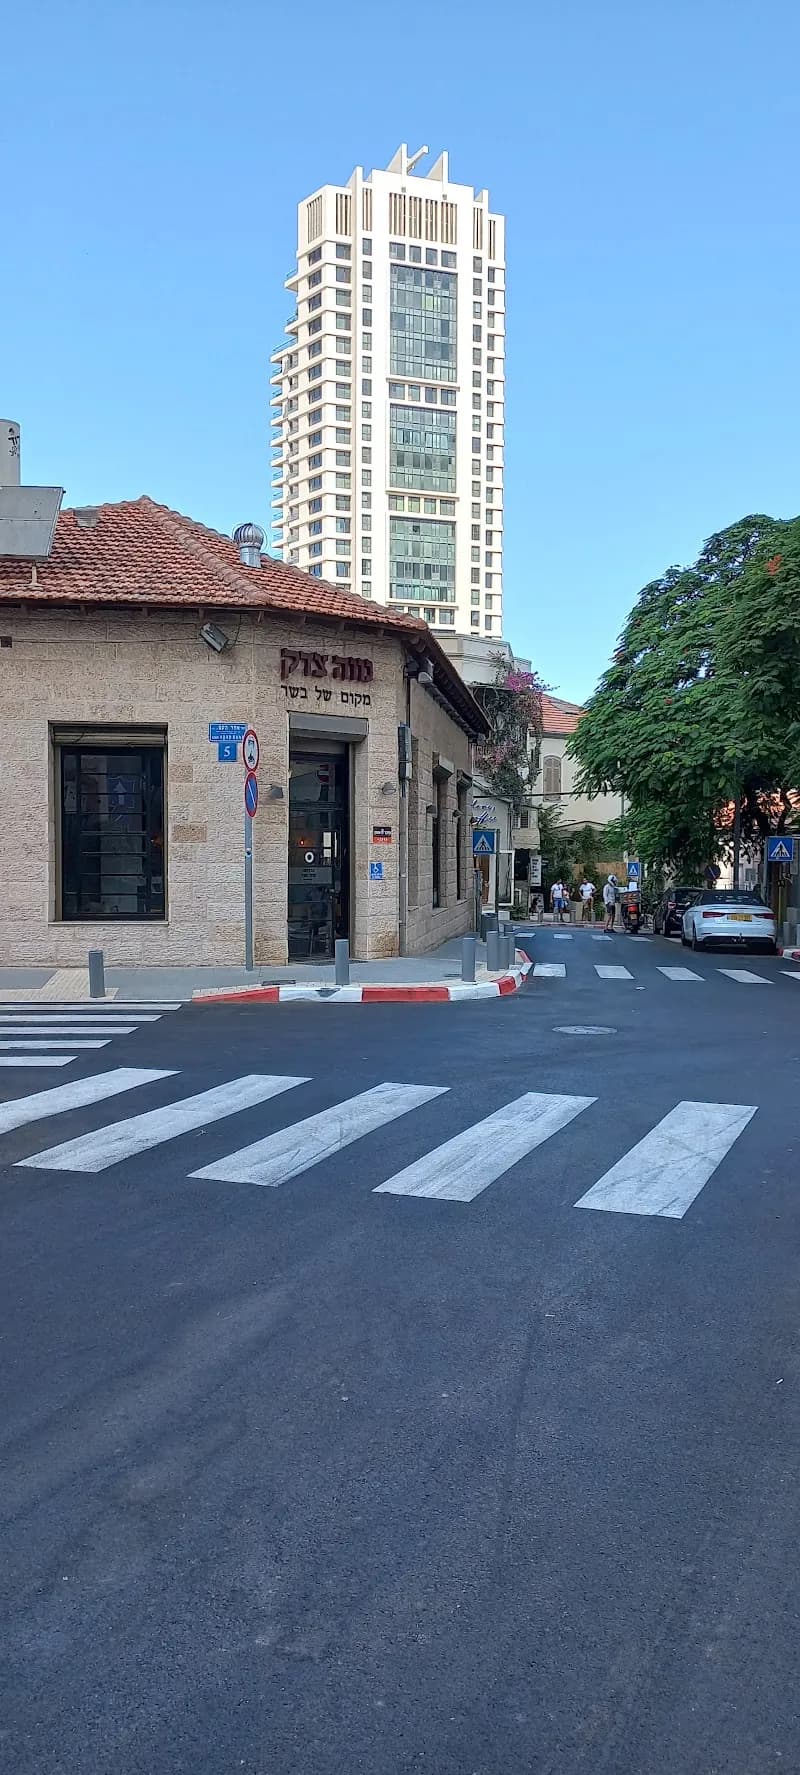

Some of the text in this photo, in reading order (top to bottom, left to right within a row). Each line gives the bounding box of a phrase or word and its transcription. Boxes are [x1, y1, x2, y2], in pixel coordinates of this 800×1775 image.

[281, 648, 374, 683] נווה צדק
[281, 685, 371, 708] מקום של בשר
[223, 745, 231, 757] 5
